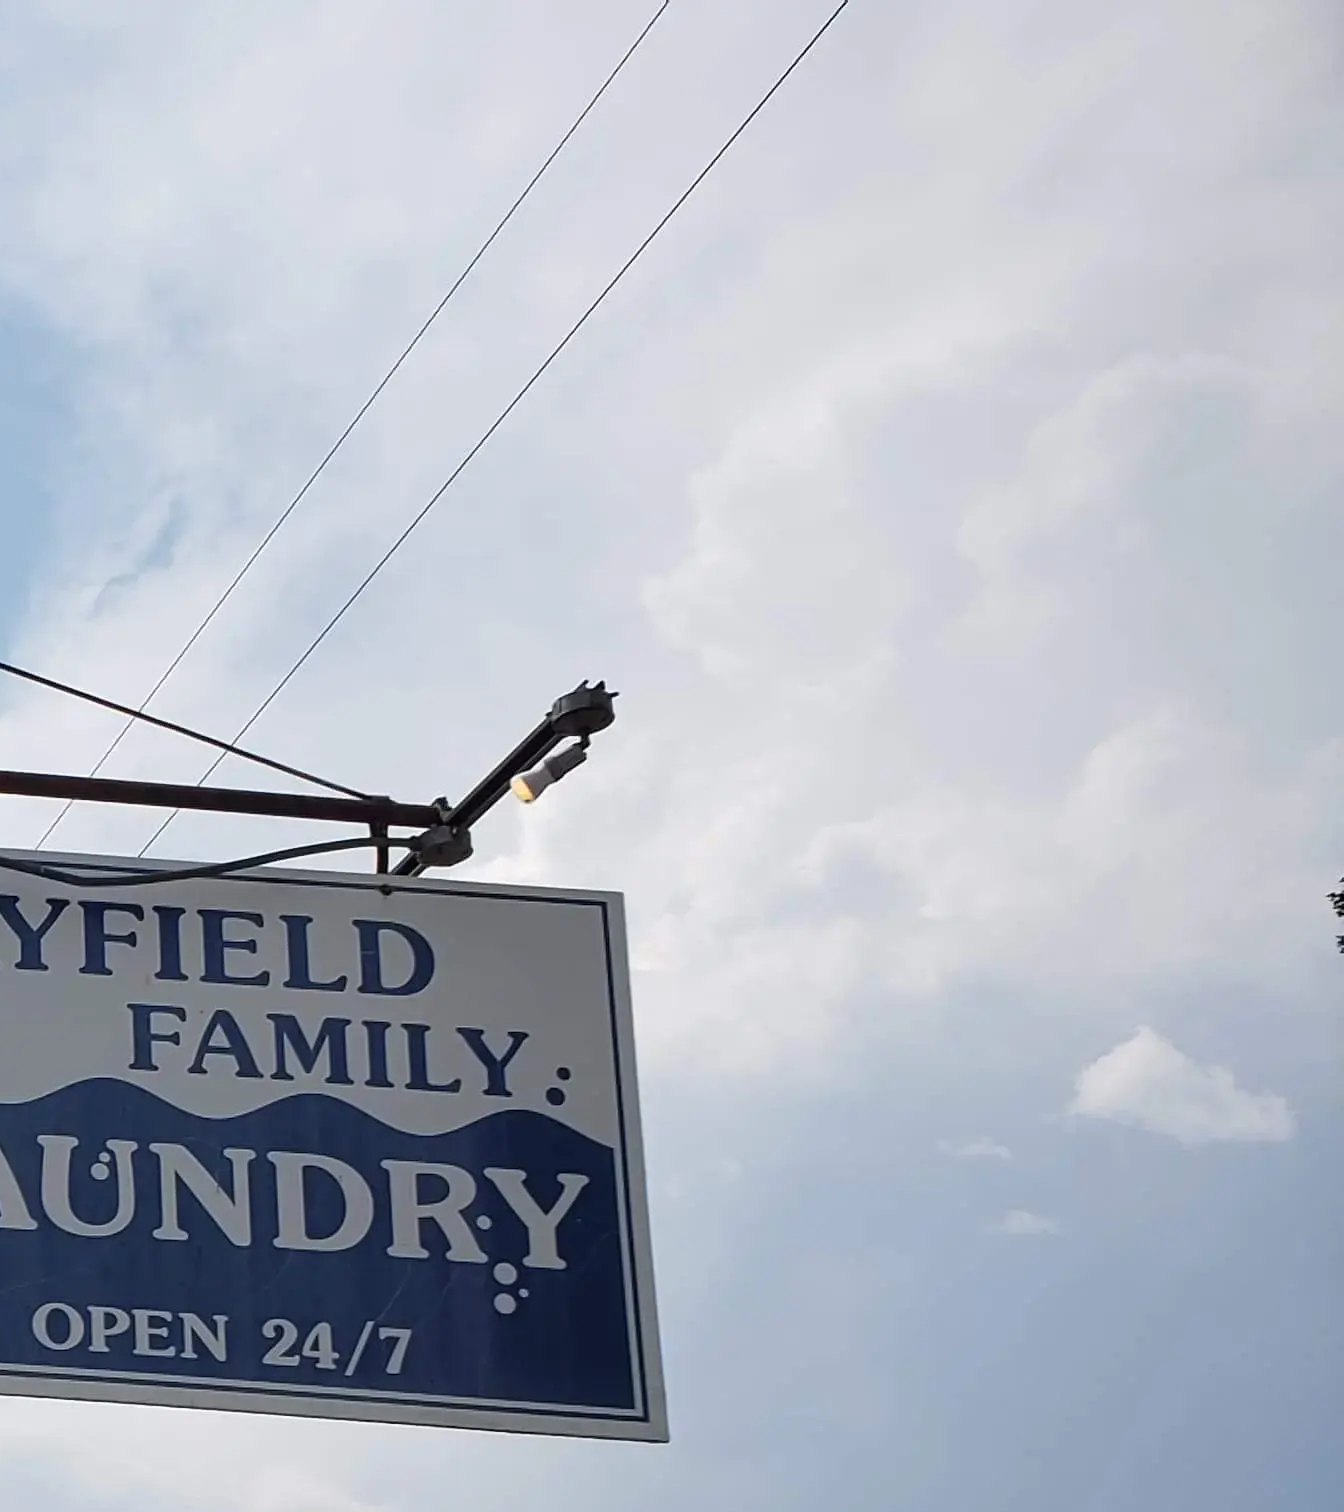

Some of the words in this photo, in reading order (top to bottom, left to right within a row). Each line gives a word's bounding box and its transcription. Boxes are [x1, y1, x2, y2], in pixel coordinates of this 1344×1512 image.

[127, 1003, 529, 1098] FAMILY
[32, 1303, 229, 1363] OPEN
[261, 1319, 413, 1377] 24/7
